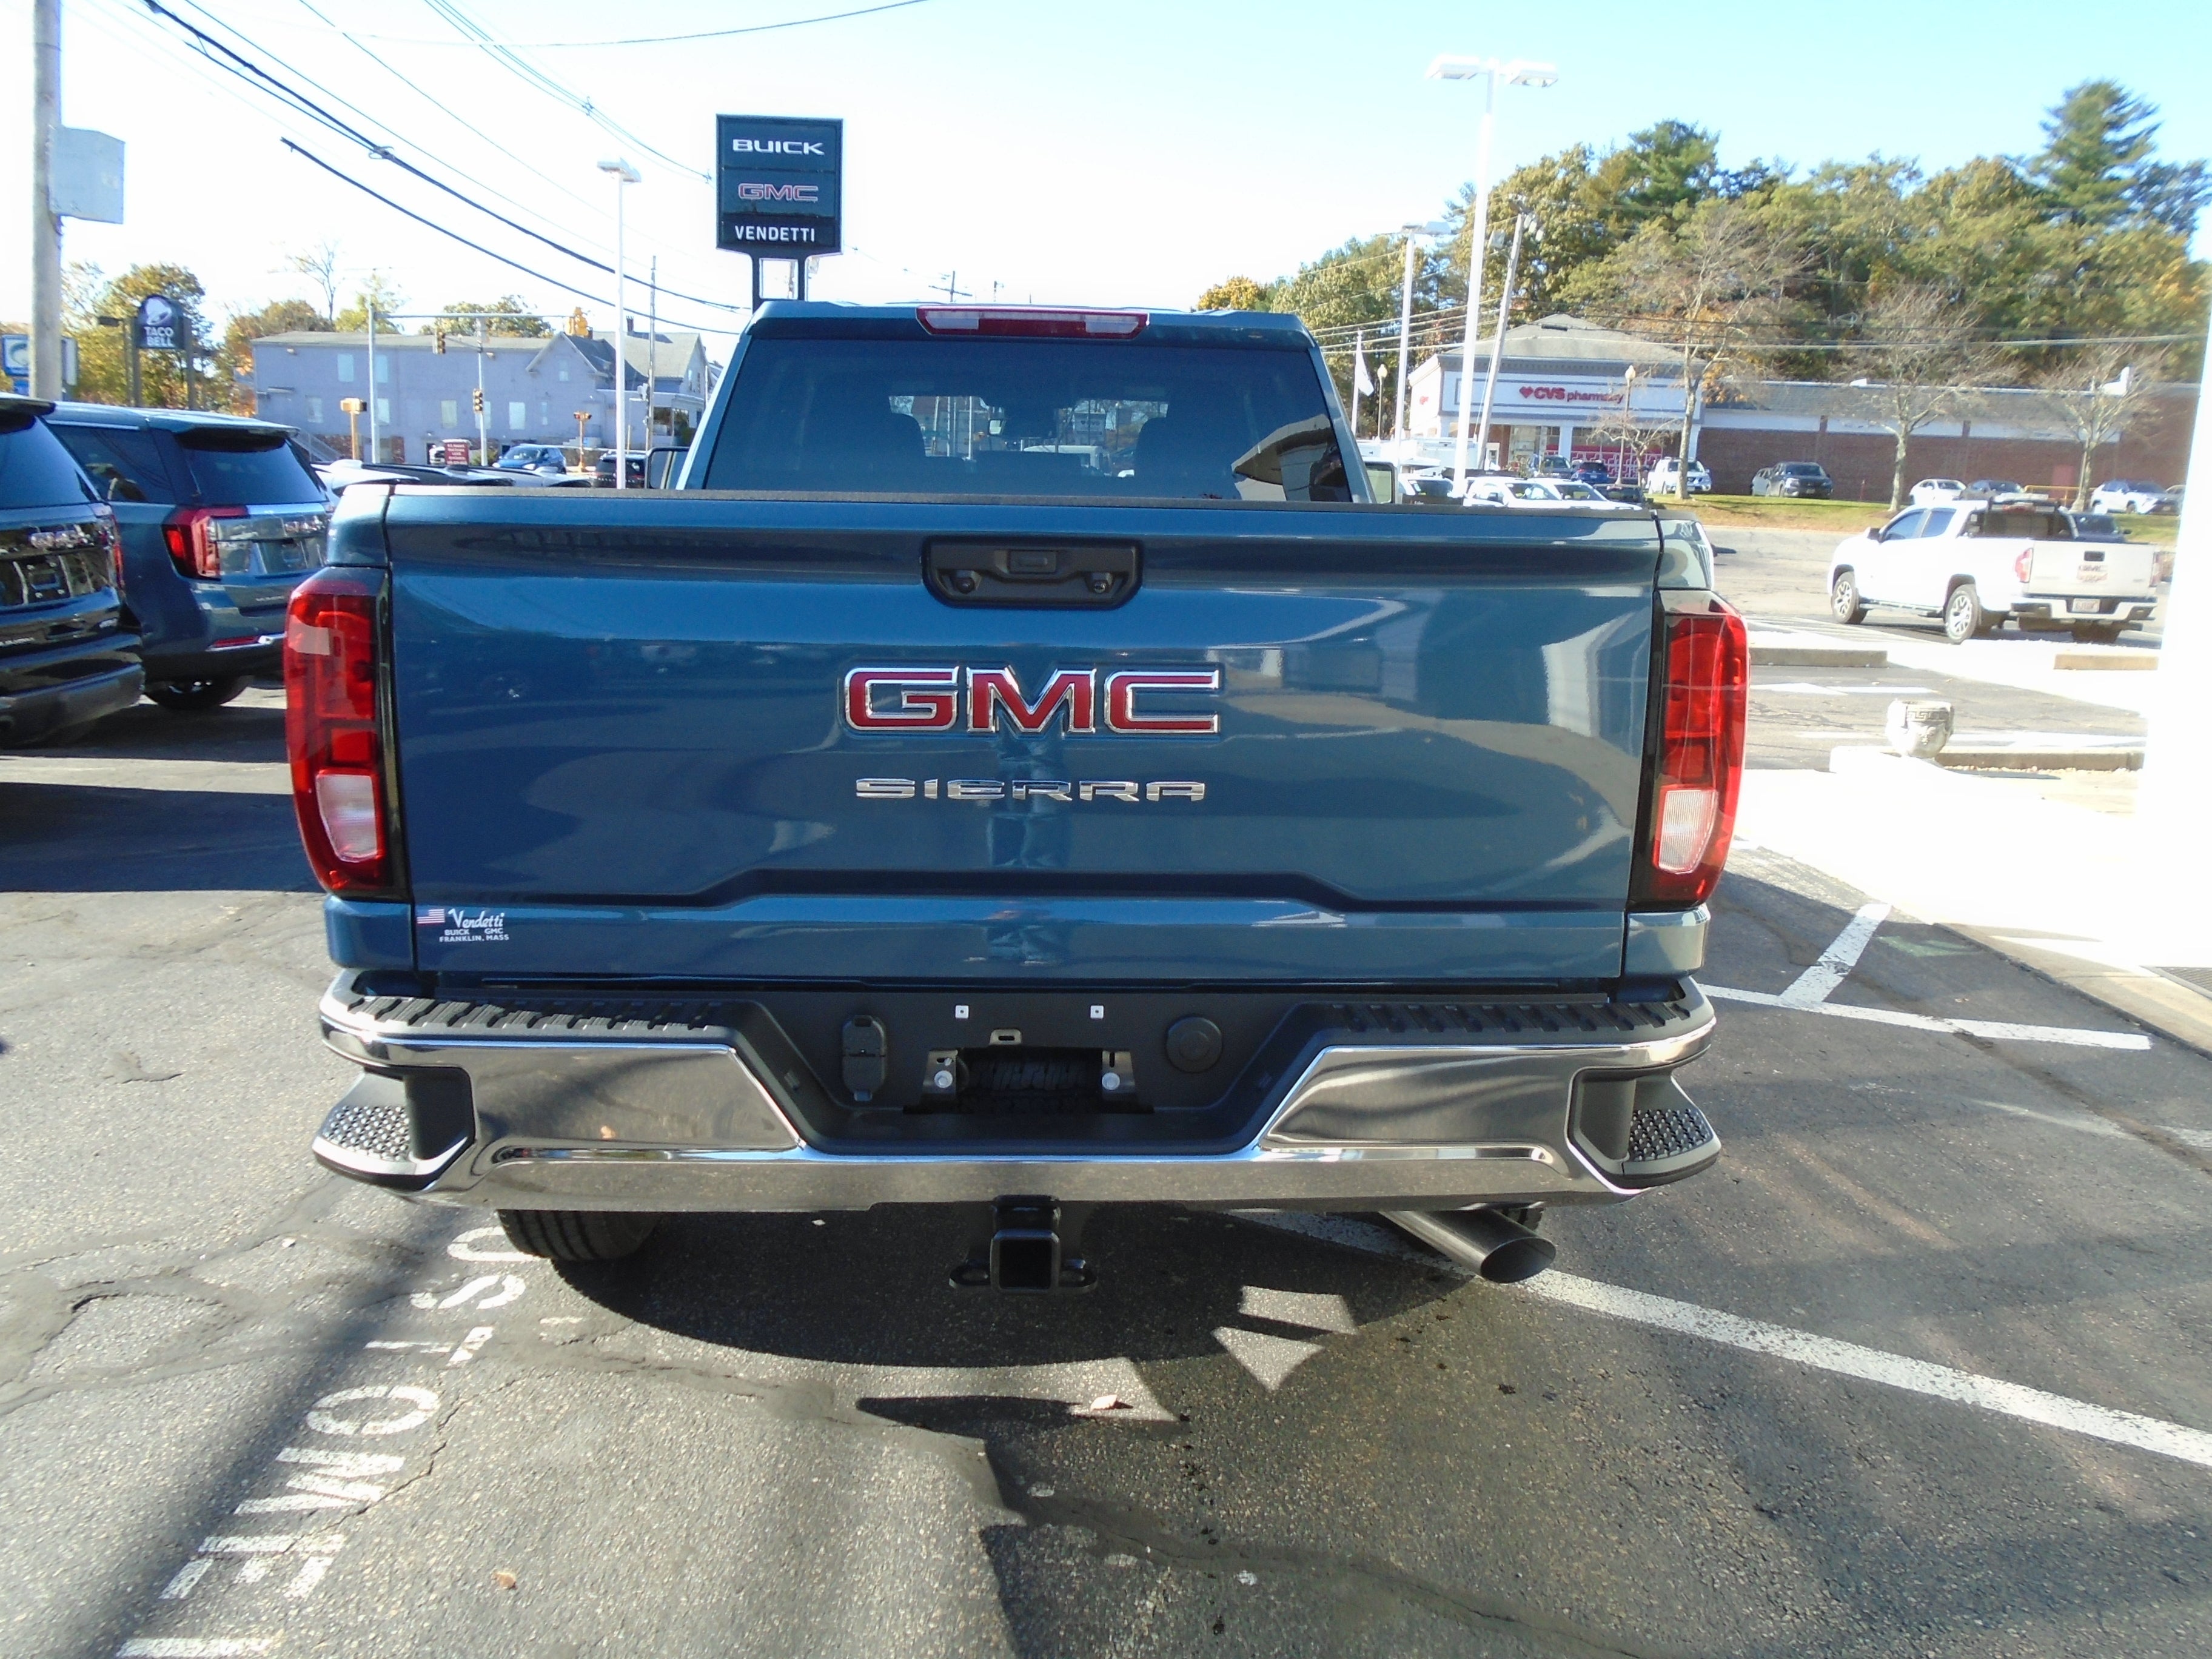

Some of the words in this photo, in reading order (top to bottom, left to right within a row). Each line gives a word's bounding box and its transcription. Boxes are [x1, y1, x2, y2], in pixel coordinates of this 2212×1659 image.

[732, 138, 825, 156] BUICK
[738, 183, 819, 202] GMC
[734, 225, 815, 242] VENDETTI
[143, 326, 174, 337] TACO
[147, 336, 175, 347] BELL
[1533, 386, 1566, 400] CVS
[844, 666, 1219, 734] GMC
[856, 778, 1206, 802] SIERRA
[447, 908, 505, 928] Vendetti
